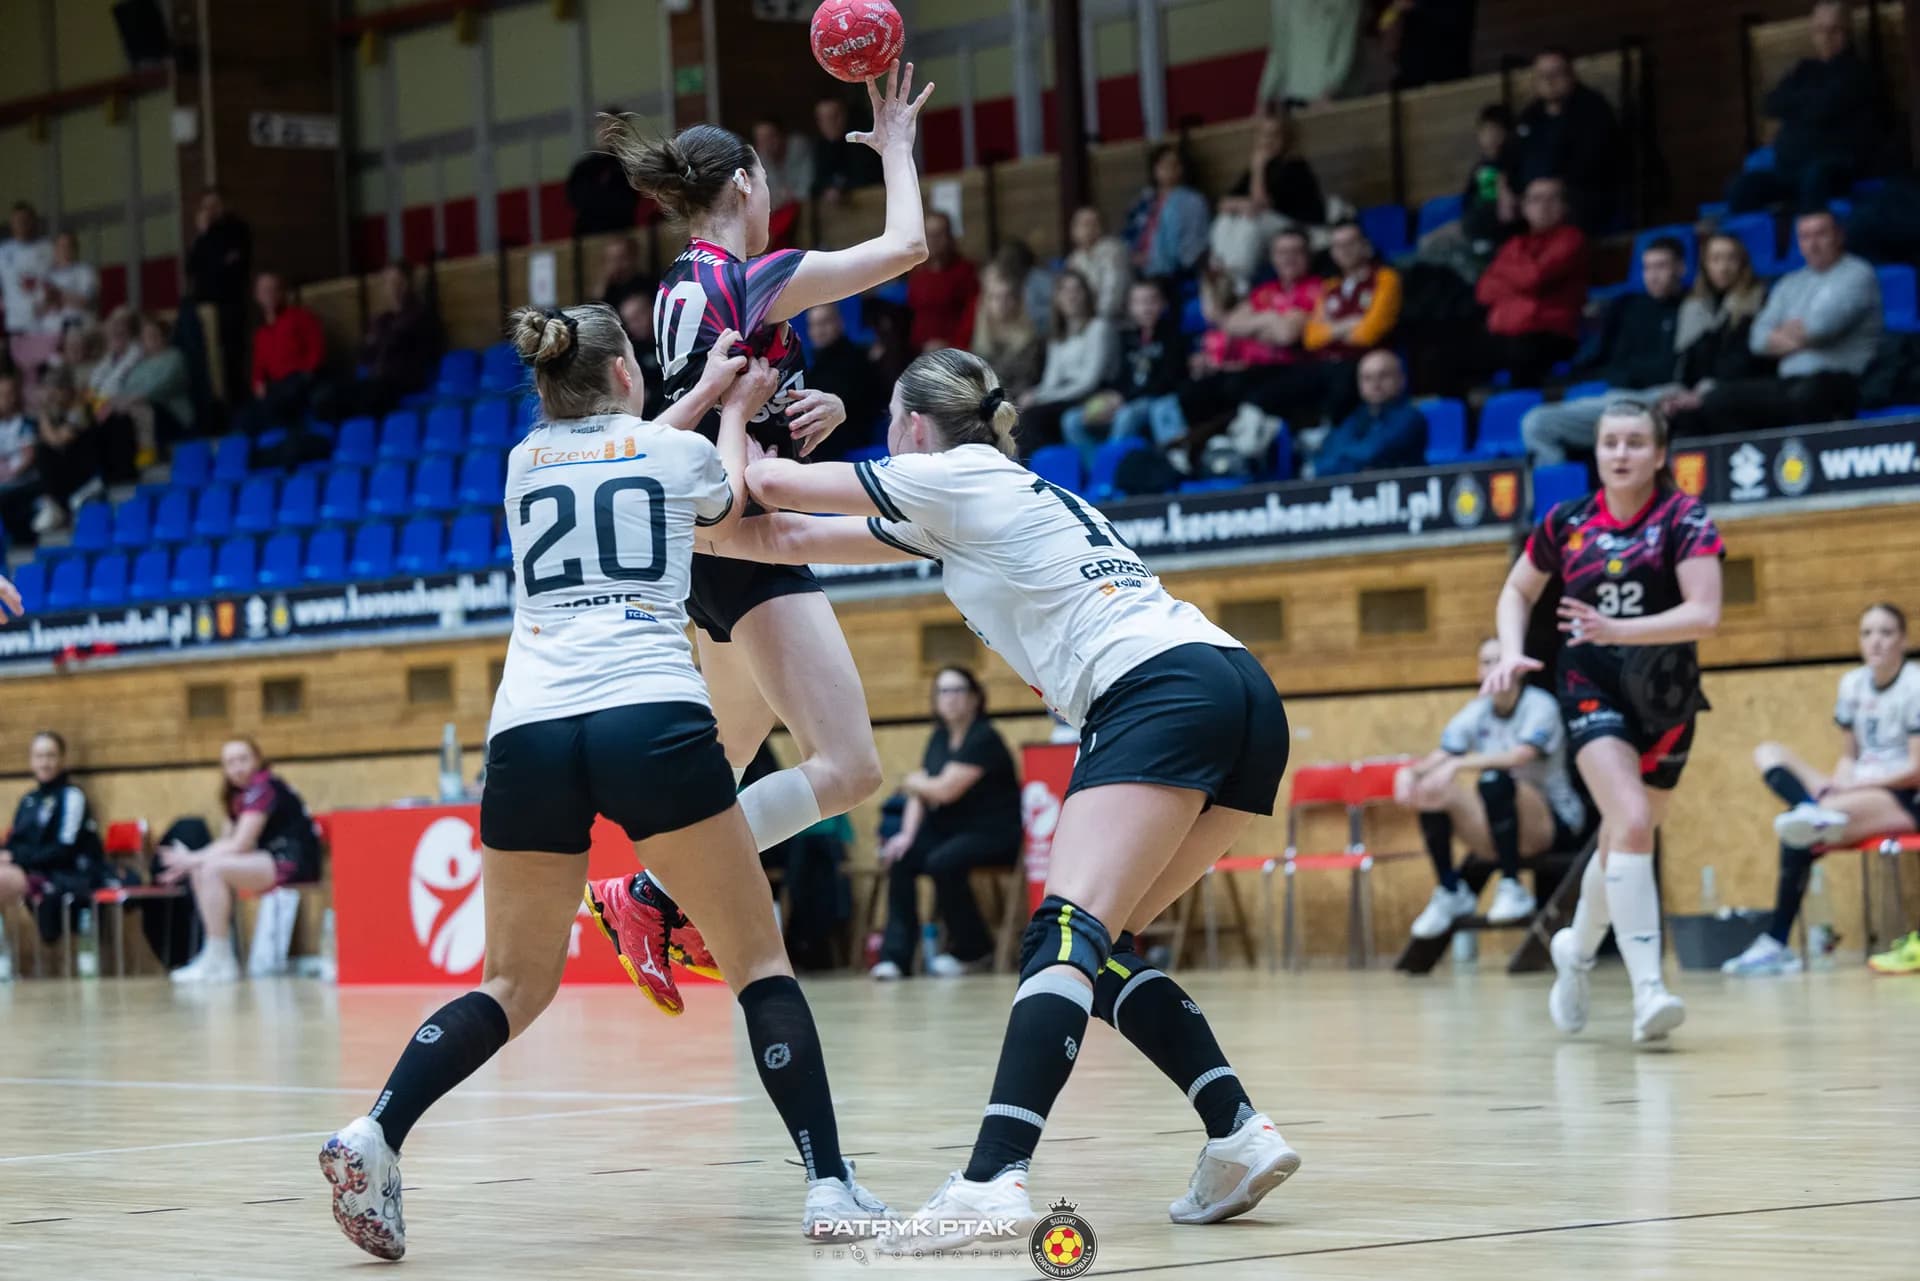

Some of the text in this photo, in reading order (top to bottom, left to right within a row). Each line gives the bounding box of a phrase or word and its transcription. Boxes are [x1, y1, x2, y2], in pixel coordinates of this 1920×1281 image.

[527, 447, 601, 467] Tczew
[520, 476, 667, 597] 20
[1110, 477, 1442, 547] ww.koronahandball.pl
[1596, 581, 1643, 615] 32
